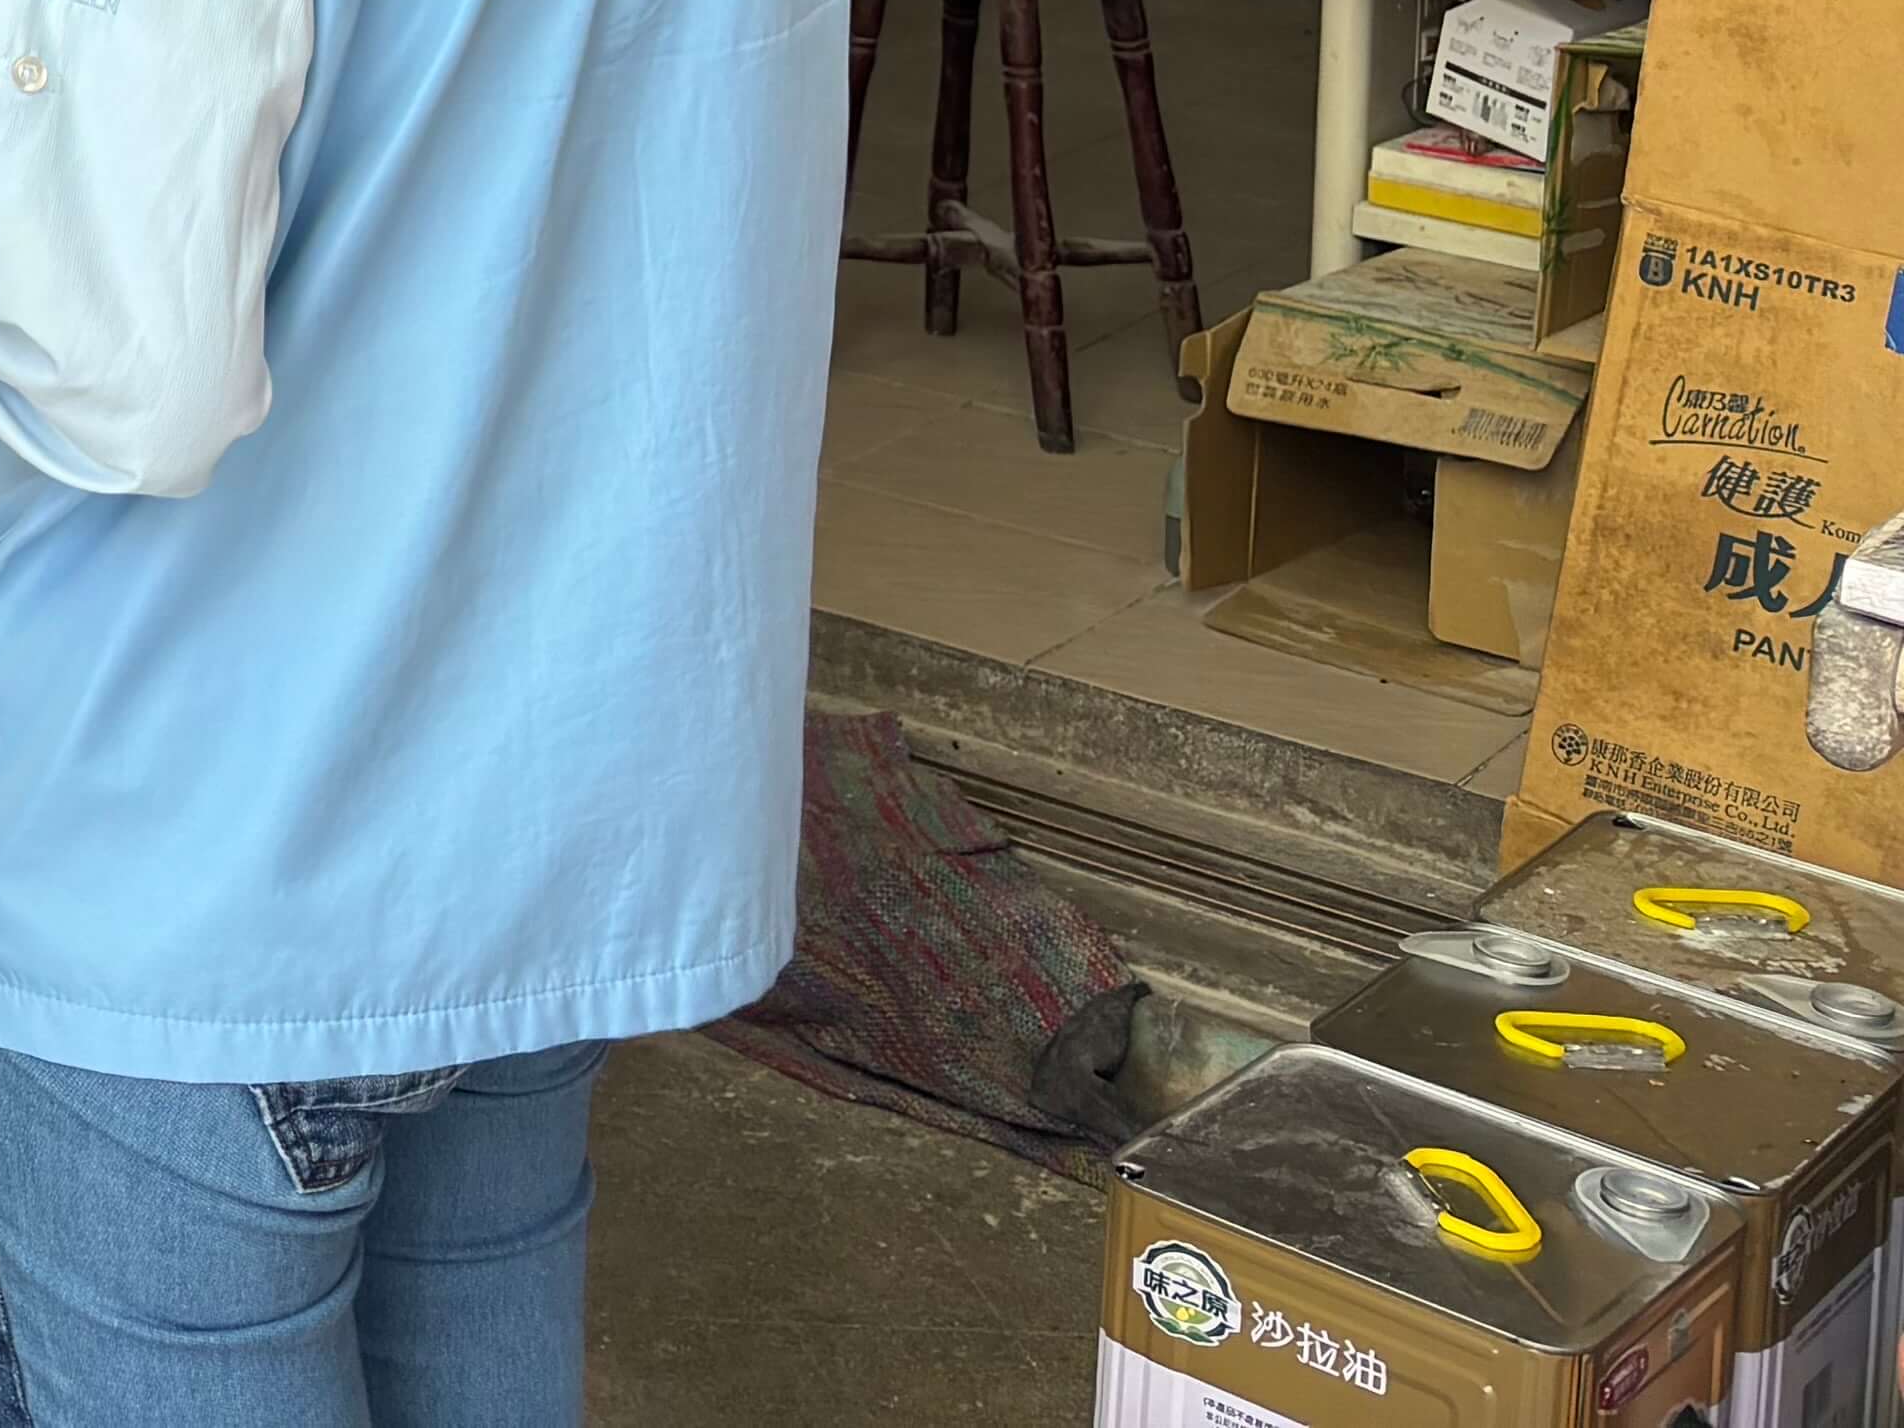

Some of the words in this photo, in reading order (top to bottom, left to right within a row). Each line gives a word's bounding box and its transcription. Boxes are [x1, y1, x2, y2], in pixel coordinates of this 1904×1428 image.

[1681, 268, 1761, 312] KNH
[1661, 375, 1800, 451] Carnation
[1700, 454, 1822, 520] 健護
[1820, 519, 1862, 545] Kom
[1732, 628, 1812, 671] PAN
[1641, 774, 1721, 812] Enterprise
[1142, 1267, 1230, 1322] 味之原
[1250, 1300, 1388, 1396] 沙拉油
